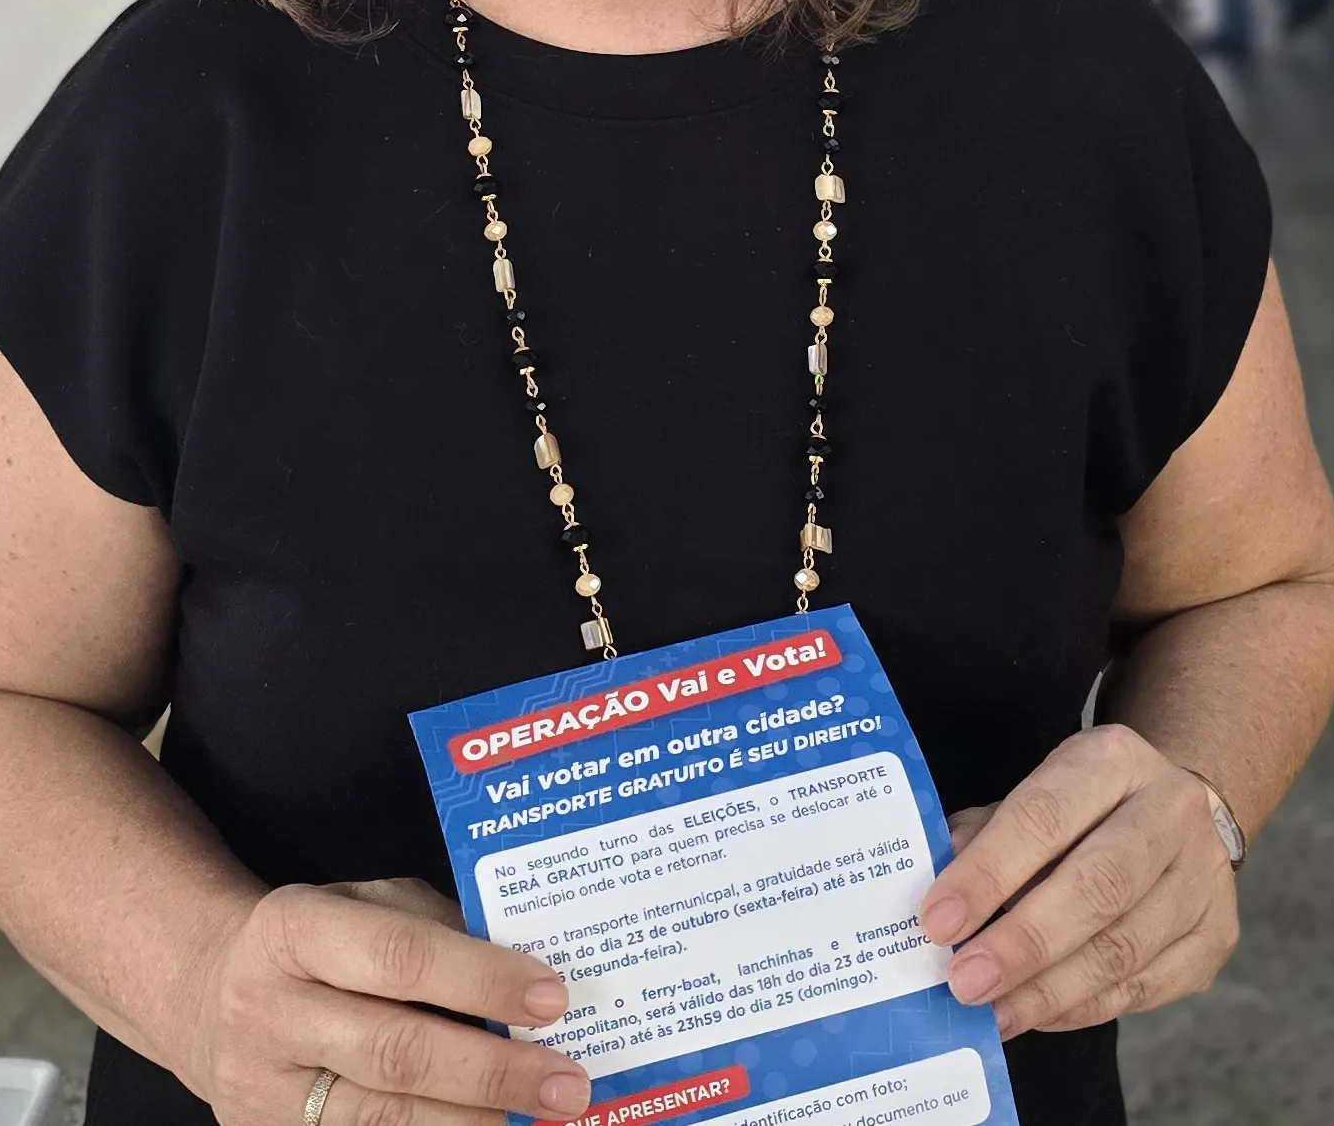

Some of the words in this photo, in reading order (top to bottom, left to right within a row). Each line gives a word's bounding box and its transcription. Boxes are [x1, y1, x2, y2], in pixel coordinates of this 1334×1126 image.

[461, 690, 650, 761] OPERAÇÃO
[656, 669, 709, 703] Vai
[717, 668, 736, 685] e
[742, 636, 827, 677] Vota!
[485, 774, 530, 804] Vai
[537, 756, 611, 790] votar
[618, 744, 660, 768] em
[667, 725, 738, 755] outra
[745, 694, 845, 735] cidade?
[467, 785, 613, 840] TRANSPORTE
[617, 757, 724, 798] GRATUITO
[729, 747, 743, 769] É
[747, 738, 788, 763] SEU
[793, 715, 882, 751] DIREITO!
[494, 865, 516, 880] No
[527, 845, 589, 871] segundo
[599, 833, 638, 852] turno
[648, 823, 674, 838] das
[683, 800, 761, 829] ELEIÇÕES,
[769, 796, 779, 806] o
[787, 765, 888, 801] TRANSPORTE
[499, 873, 541, 898] SERÁ
[547, 854, 624, 885] GRATUITO
[630, 846, 663, 865] para
[668, 833, 710, 854] quem
[714, 819, 765, 843] precisa
[769, 813, 786, 825] se
[791, 795, 849, 819] deslocar
[855, 786, 878, 803] até
[883, 784, 893, 795] o
[503, 888, 576, 918] município
[578, 877, 616, 897] onde
[618, 869, 652, 885] vota
[654, 865, 664, 876] e
[667, 848, 727, 873] retornar.
[549, 935, 559, 946] o
[563, 913, 639, 943] transporte
[743, 882, 752, 893] a
[755, 859, 832, 892] gratuidade
[835, 848, 865, 868] será
[868, 837, 910, 858] válida
[545, 950, 572, 967] 18h
[575, 944, 595, 960] do
[599, 937, 623, 953] dia
[626, 929, 644, 946] 23
[649, 925, 668, 940] de
[671, 909, 730, 933] outubro
[733, 882, 819, 918] (sexta-feira)
[823, 873, 846, 892] até
[849, 870, 865, 884] às
[867, 861, 892, 879] 12h
[895, 857, 914, 871] do
[569, 940, 688, 982] (segunda-feira).
[563, 1005, 597, 1025] para
[614, 998, 625, 1009] o
[641, 972, 721, 1002] ferry-boat,
[737, 947, 814, 977] lanchinhas
[830, 940, 840, 951] e
[855, 914, 920, 944] transport
[565, 1035, 626, 1061] ta-feira)
[629, 1026, 654, 1046] até
[657, 1024, 673, 1038] às
[676, 1010, 722, 1033] 23h59
[726, 1005, 746, 1020] do
[749, 998, 773, 1014] dia
[775, 990, 794, 1007] 25
[797, 969, 878, 1002] (domingo).
[645, 1001, 676, 1021] será
[679, 991, 725, 1012] válido
[728, 984, 755, 999] das
[756, 974, 782, 991] 18h
[785, 969, 805, 984] do
[808, 961, 832, 978] dia
[834, 954, 853, 971] 23
[856, 949, 874, 964] de
[607, 1078, 730, 1126] APRESENTAR?
[836, 1089, 869, 1107] com
[871, 1079, 908, 1098] foto;
[856, 1097, 939, 1126] documento
[942, 1088, 970, 1107] que
